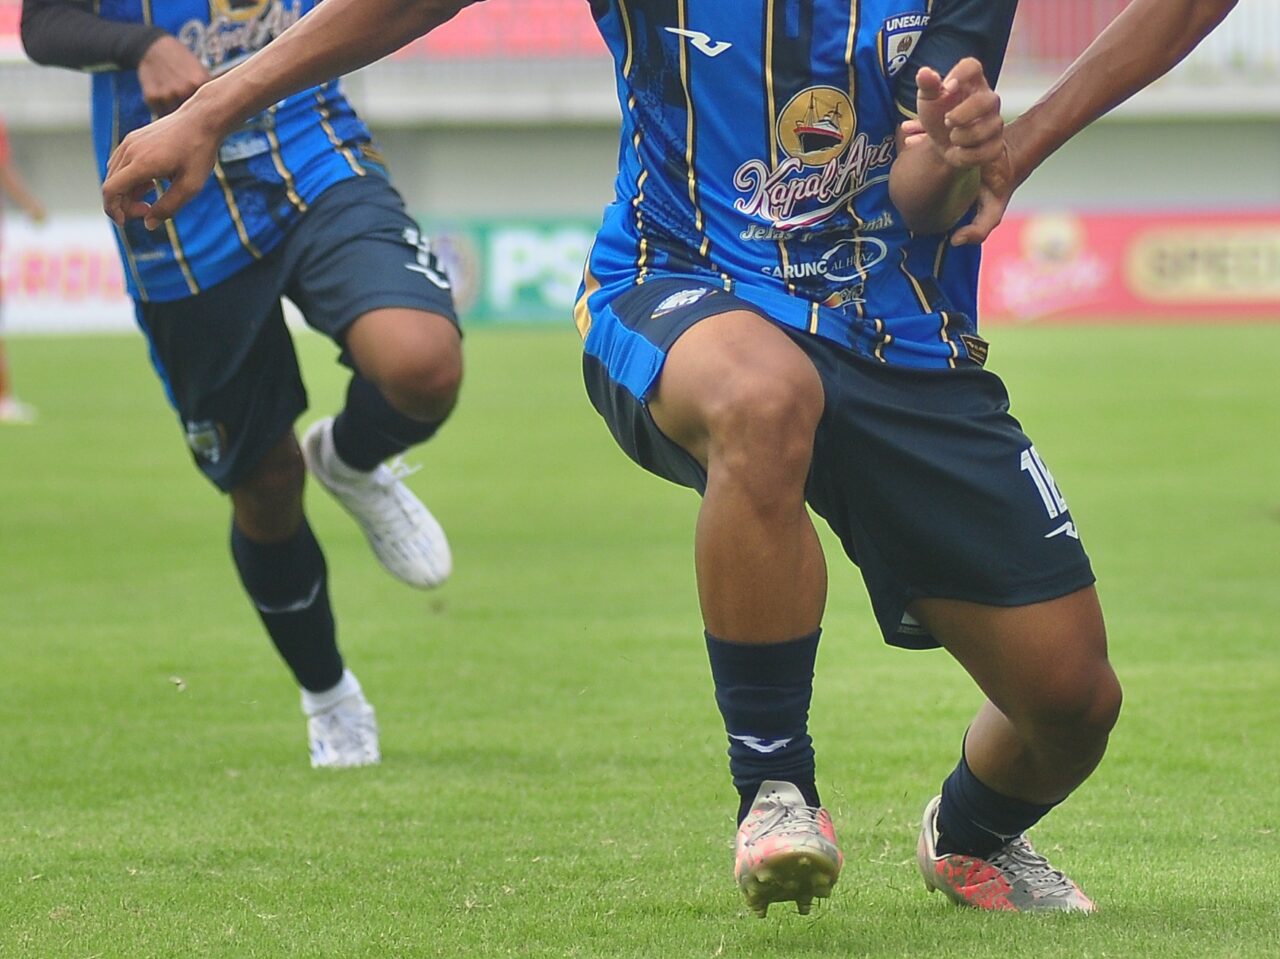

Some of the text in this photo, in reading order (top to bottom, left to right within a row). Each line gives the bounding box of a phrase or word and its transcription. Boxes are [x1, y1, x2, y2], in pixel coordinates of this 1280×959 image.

[733, 132, 894, 222] Kapal Api
[761, 259, 828, 279] SARUNG
